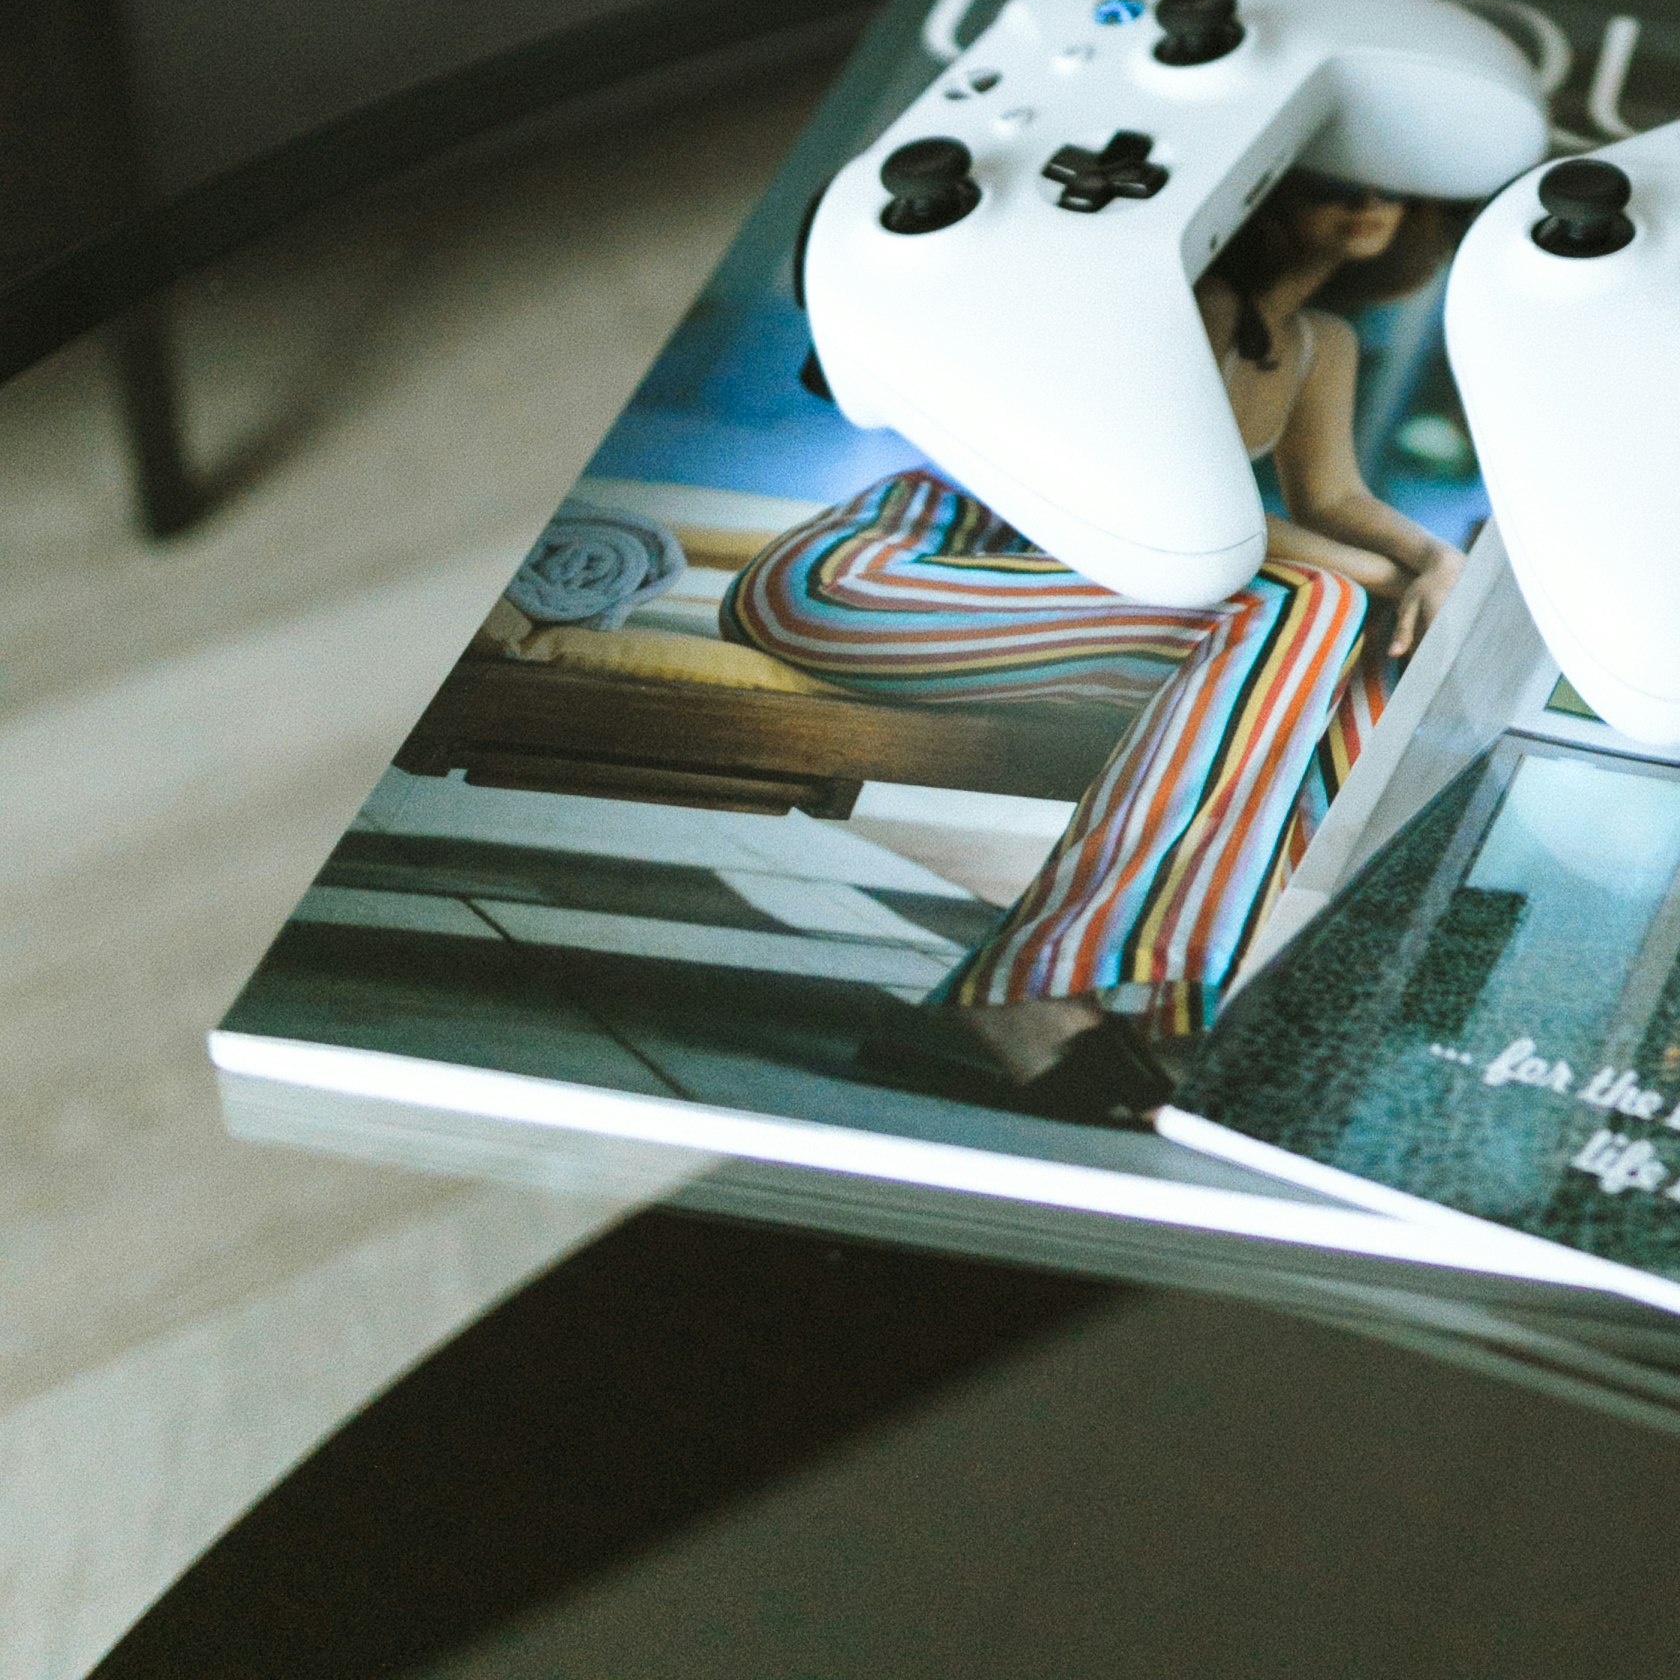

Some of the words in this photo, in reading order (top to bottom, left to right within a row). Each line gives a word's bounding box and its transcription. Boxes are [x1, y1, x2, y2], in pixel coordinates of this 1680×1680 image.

[1483, 1036, 1575, 1095] for
[1575, 1065, 1665, 1121] the
[1571, 1129, 1671, 1195] life
